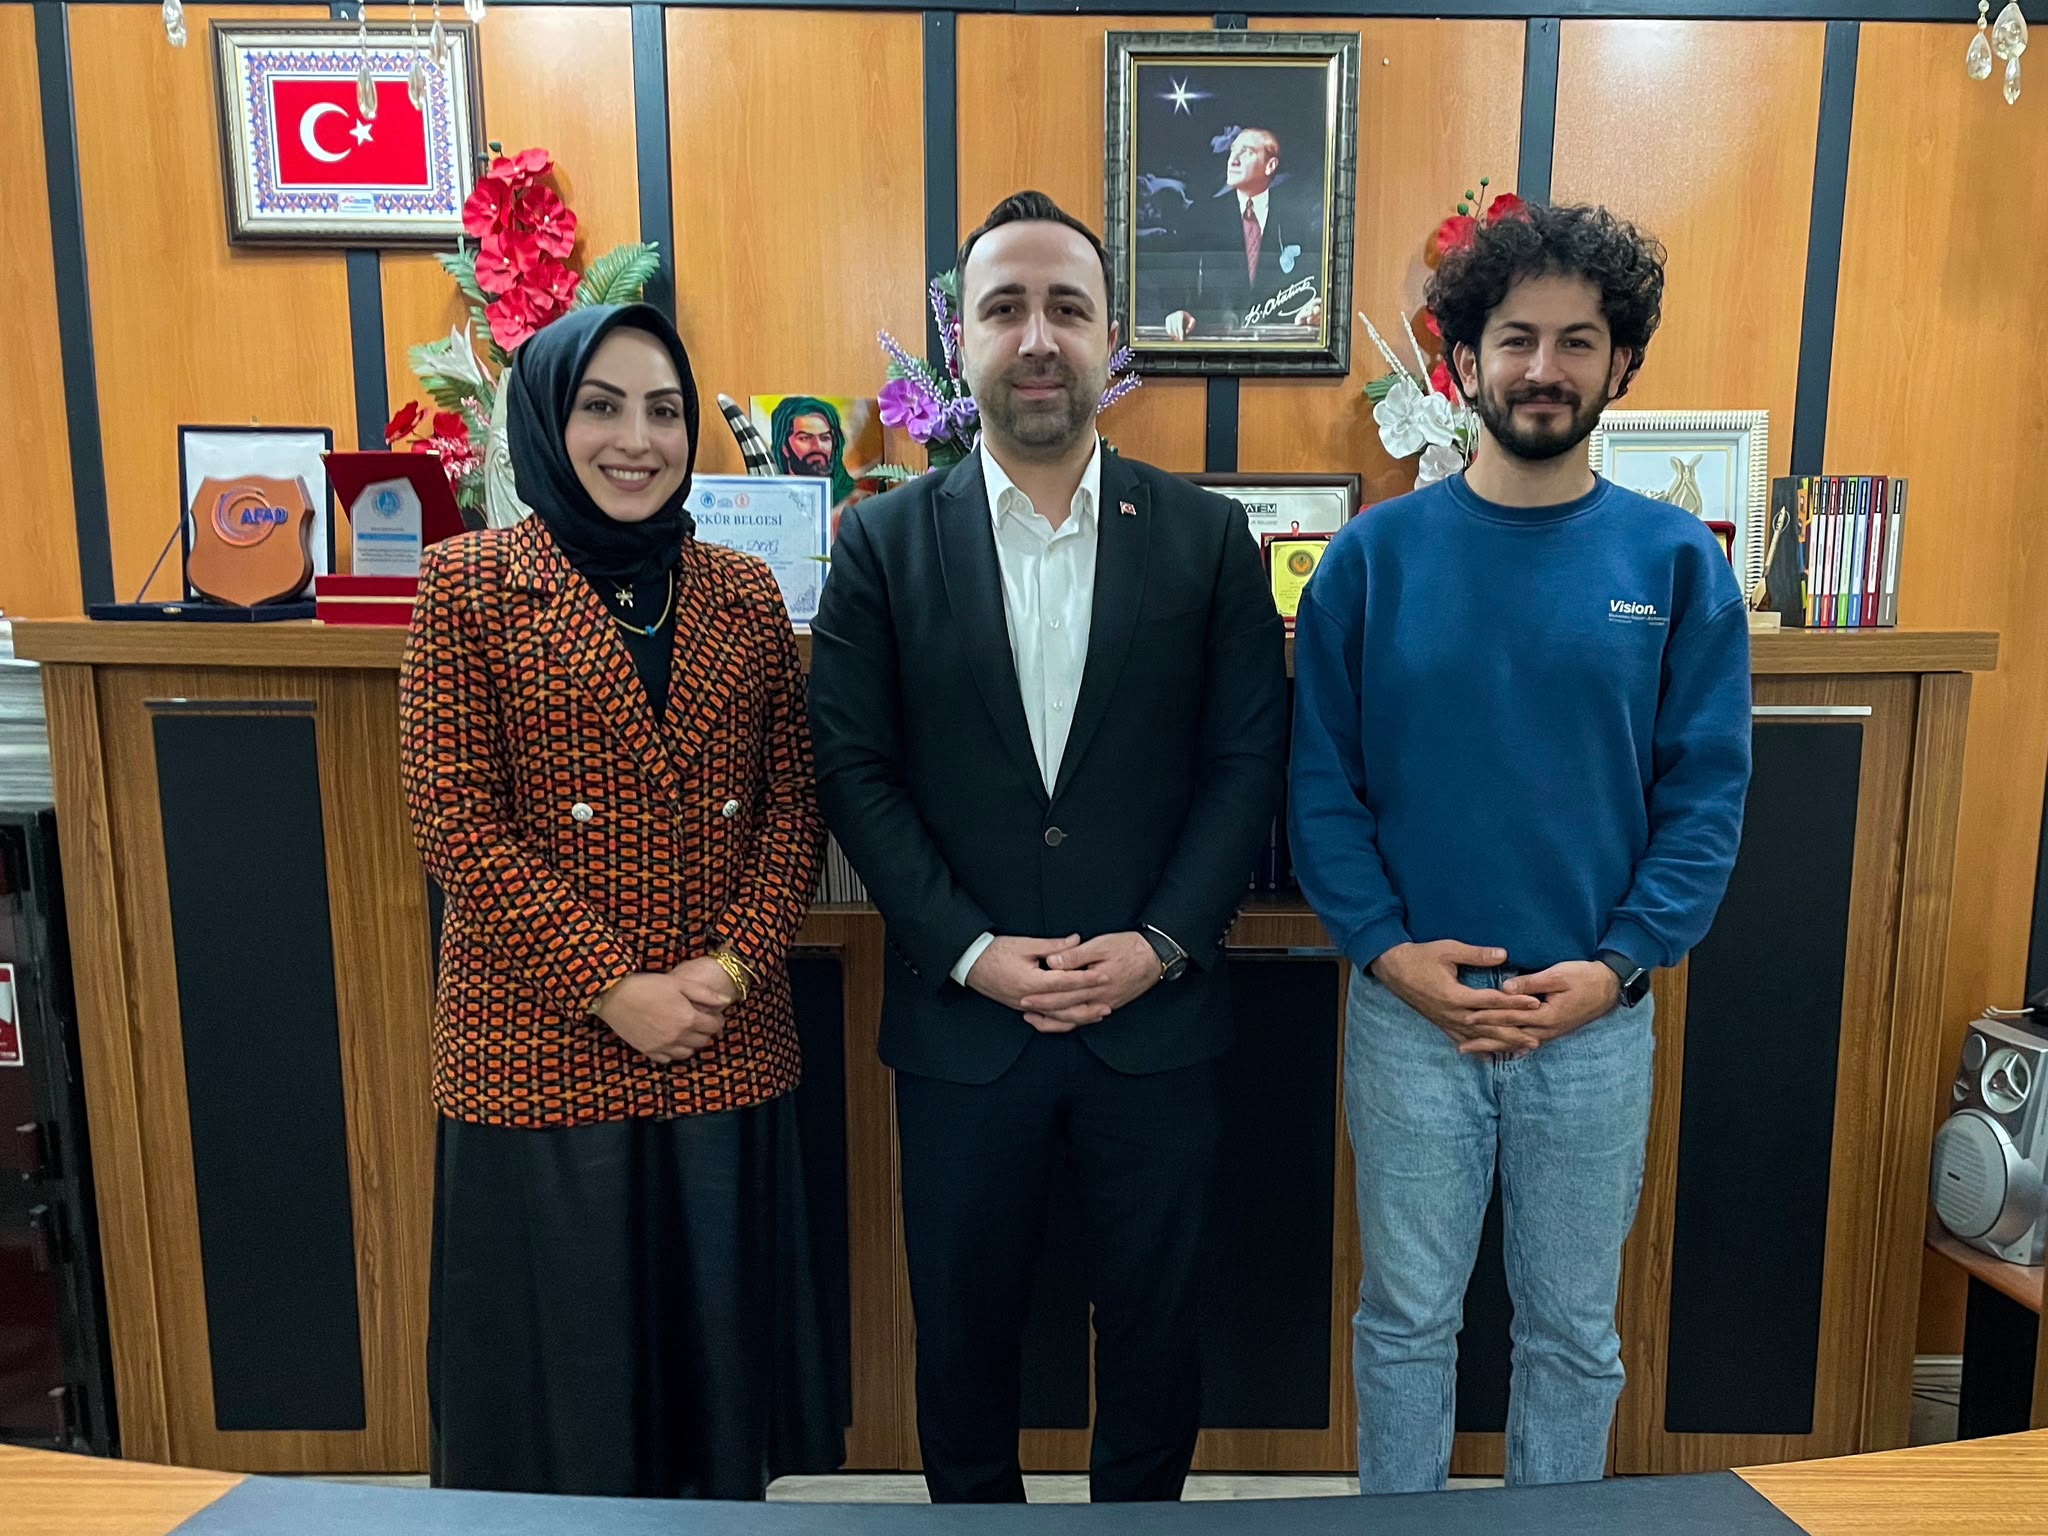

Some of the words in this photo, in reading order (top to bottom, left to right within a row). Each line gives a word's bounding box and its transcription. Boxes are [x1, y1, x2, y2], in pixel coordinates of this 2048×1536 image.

[1243, 503, 1277, 513] ATEM
[241, 507, 289, 525] AFAD
[693, 512, 731, 525] KKÜR
[734, 513, 782, 526] BELGESİ
[1610, 599, 1657, 615] Vision.
